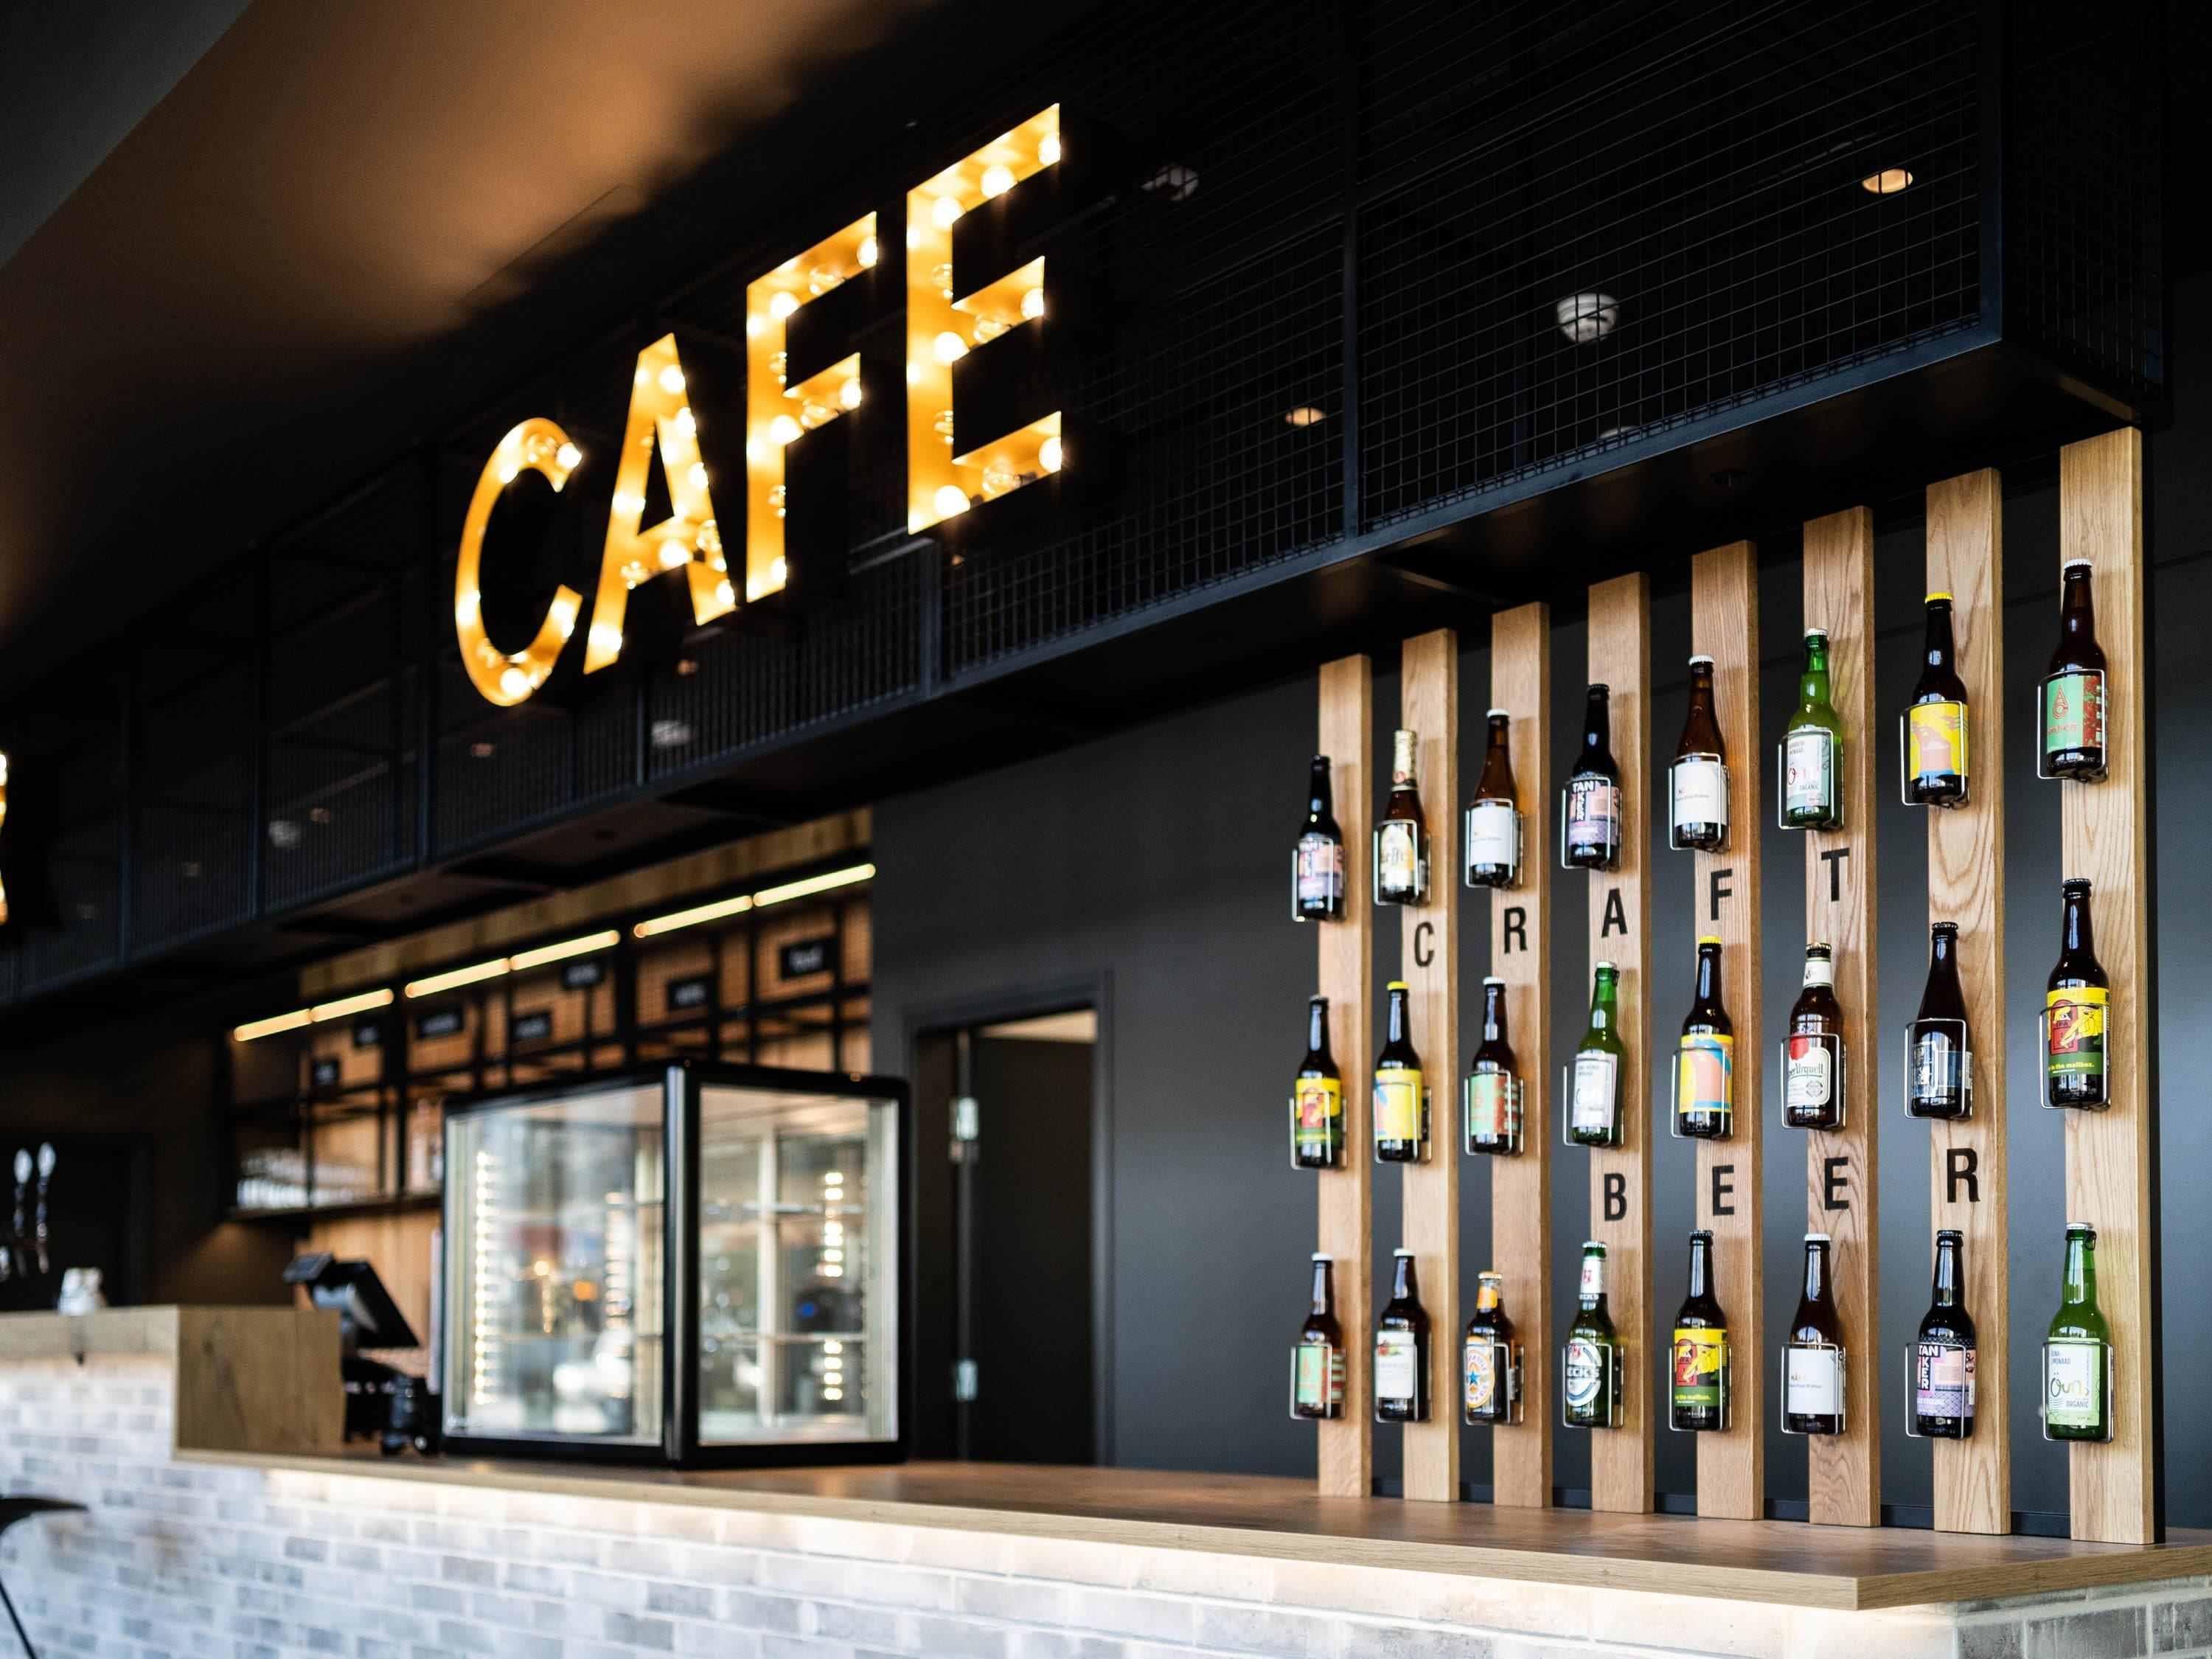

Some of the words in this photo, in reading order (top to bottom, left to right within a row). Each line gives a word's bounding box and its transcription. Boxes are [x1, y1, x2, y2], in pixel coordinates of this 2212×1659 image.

[454, 102, 1062, 707] CAFE
[1413, 847, 1850, 968] CRAFT
[1604, 1147, 1980, 1221] BEER
[1919, 1345, 1939, 1357] TAN
[1921, 1357, 1930, 1390] KER
[2065, 1400, 2089, 1408] ORGANIC
